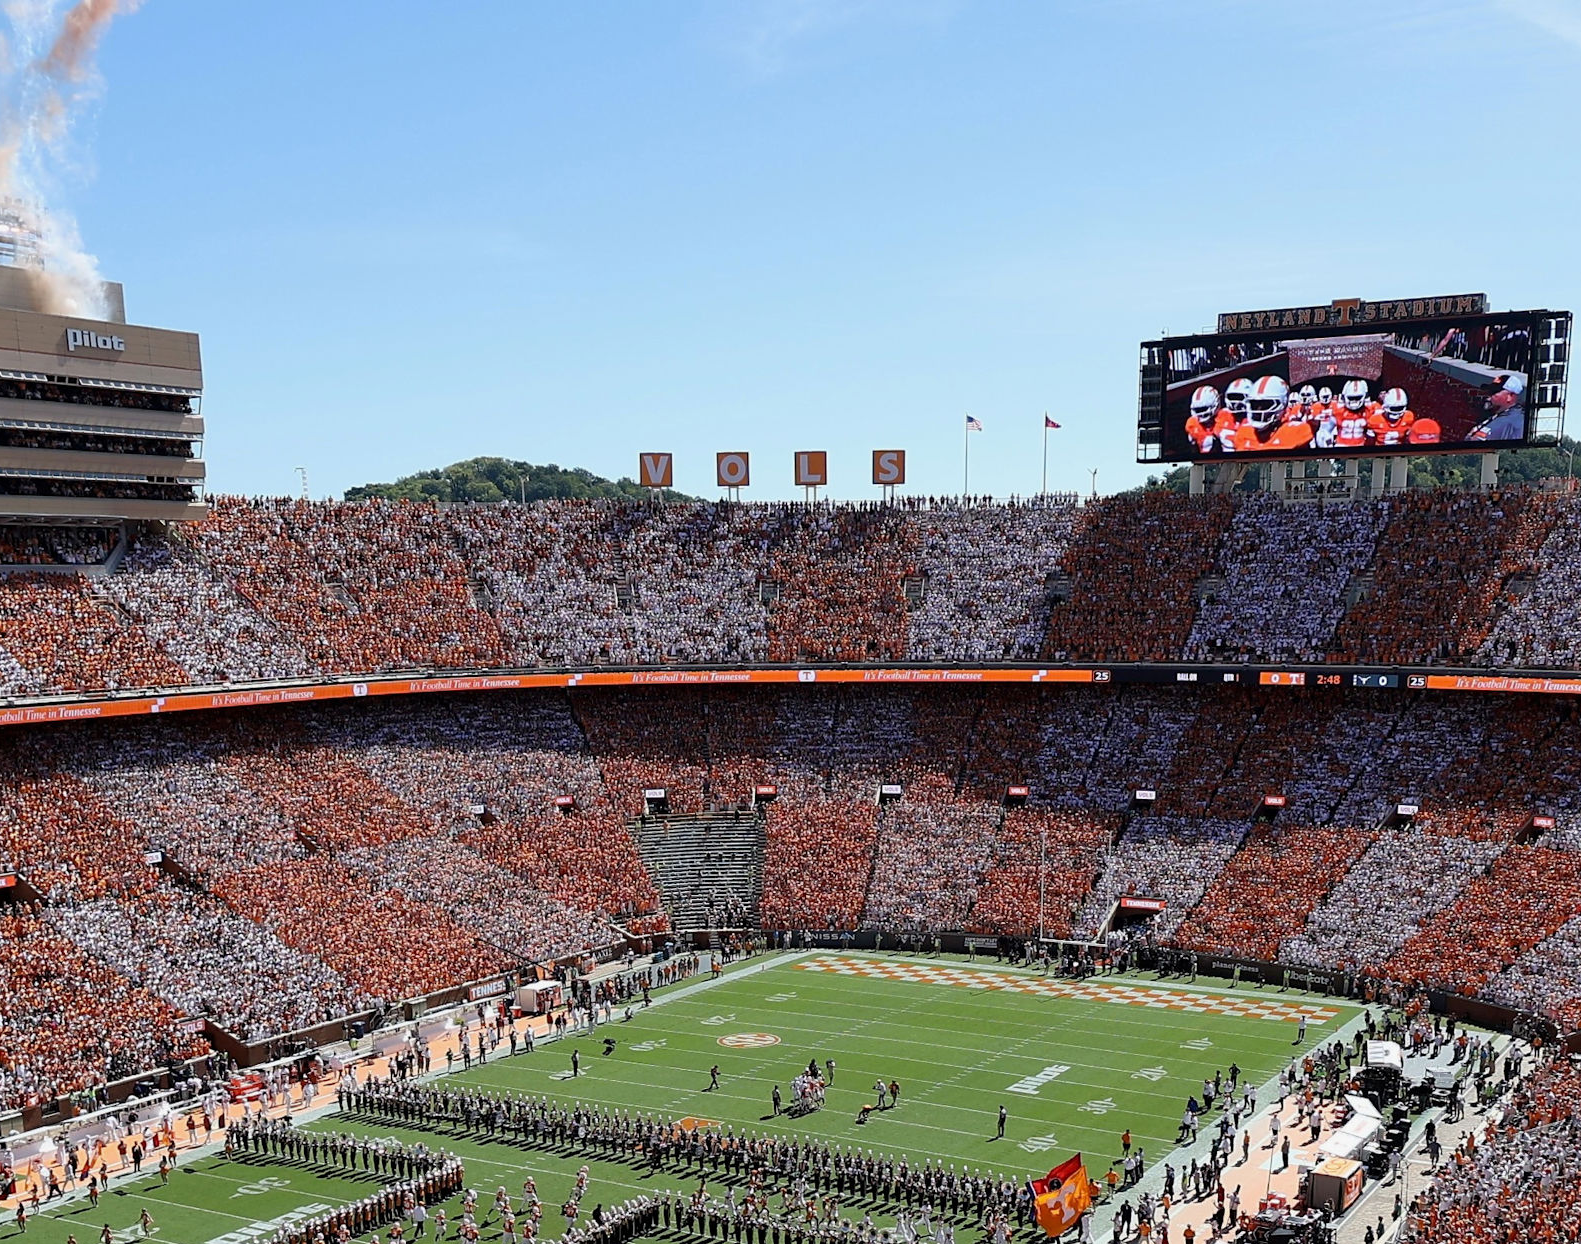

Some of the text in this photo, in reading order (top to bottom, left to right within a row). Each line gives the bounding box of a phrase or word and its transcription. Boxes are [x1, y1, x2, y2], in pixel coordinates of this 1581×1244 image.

[1225, 296, 1475, 330] NEYLAND T STADIUM
[710, 672, 750, 681] Tennessee
[803, 672, 810, 680] T
[942, 672, 982, 680] Tennessee
[1094, 672, 1109, 680] 25
[1271, 674, 1300, 684] 0 T
[1317, 675, 1340, 684] 2:48
[482, 678, 520, 688] Tennessee
[1378, 676, 1388, 686] 0
[1410, 678, 1424, 686] 25
[1471, 679, 1506, 688] Football
[1510, 680, 1530, 690] Time
[1532, 682, 1540, 690] in
[356, 685, 364, 694] T
[280, 691, 314, 700] Tennessee
[25, 710, 46, 720] Time
[48, 708, 56, 718] in
[58, 706, 101, 717] Tennessee
